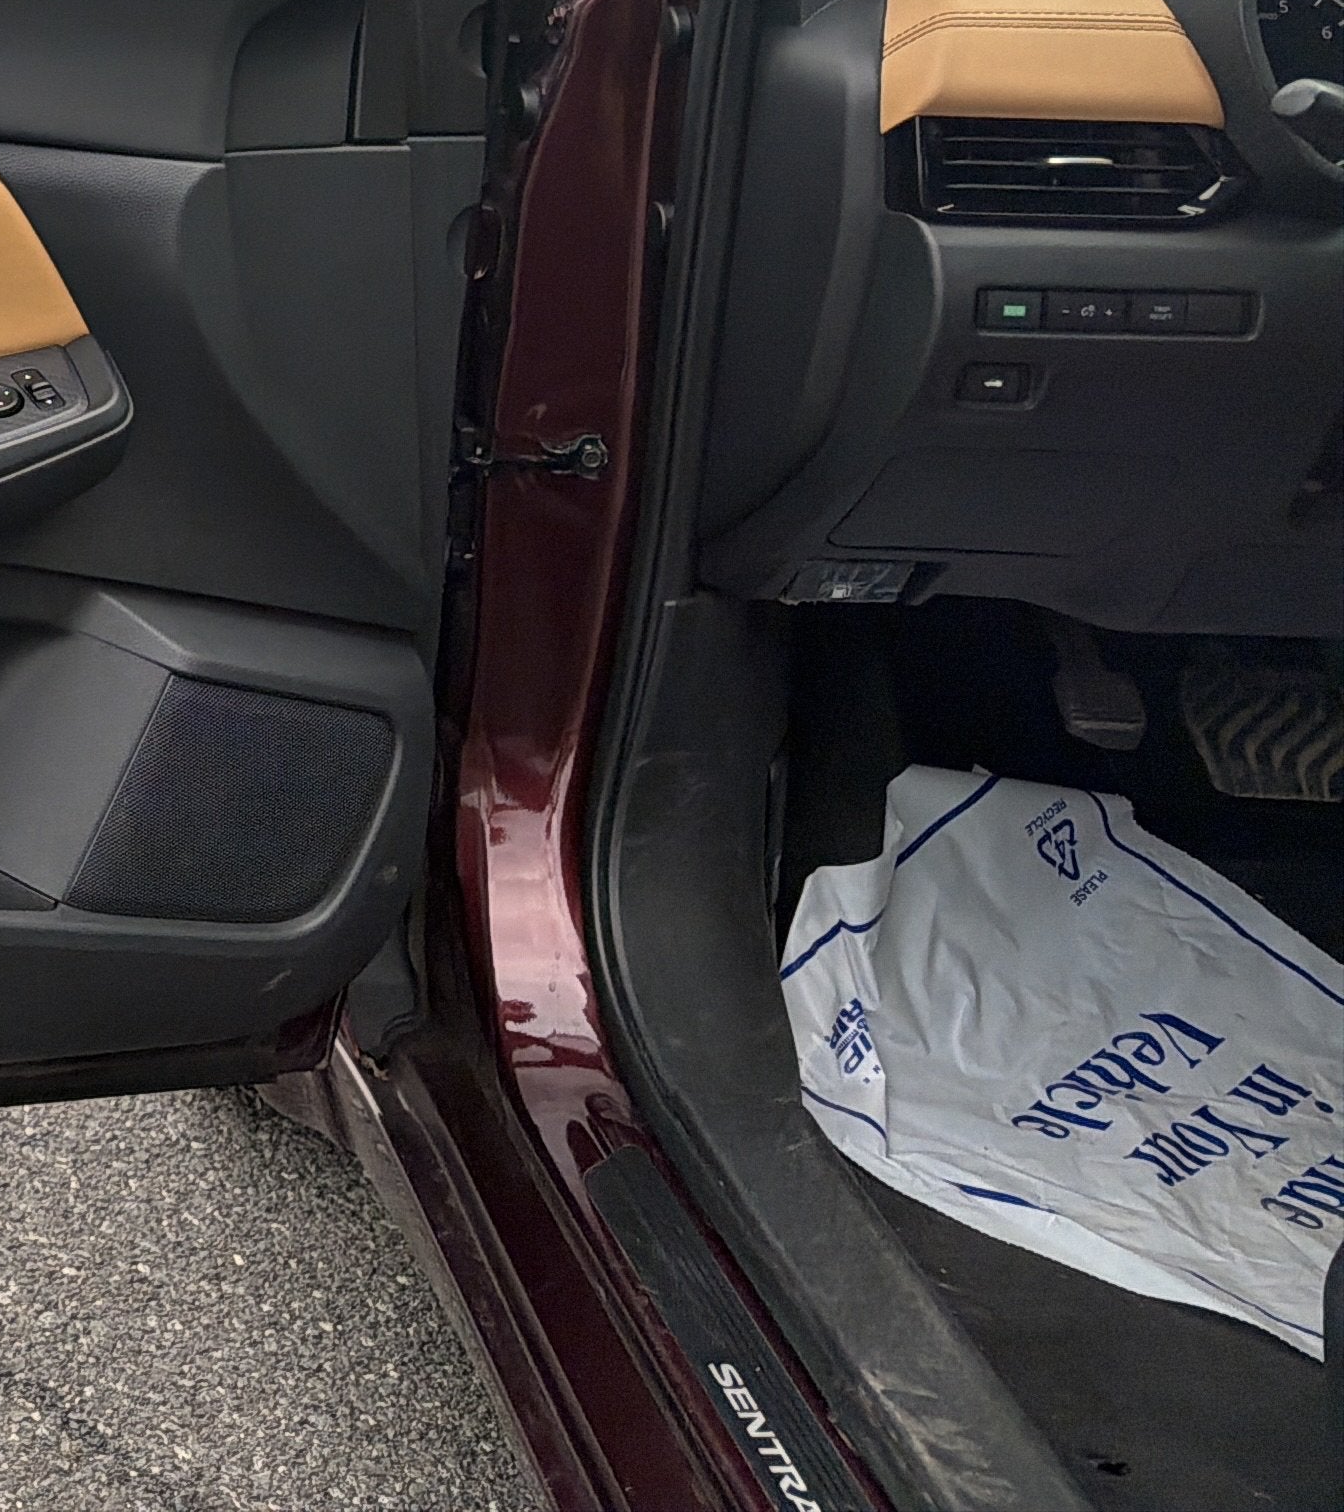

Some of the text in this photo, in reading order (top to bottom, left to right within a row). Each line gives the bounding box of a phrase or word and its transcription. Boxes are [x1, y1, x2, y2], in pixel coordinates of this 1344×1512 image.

[1278, 0, 1289, 14] 5
[1321, 25, 1333, 40] 6
[1025, 798, 1067, 837] RECYCLE
[1070, 870, 1108, 906] PLEASE
[1011, 1013, 1226, 1139] Vehicle
[1124, 1063, 1335, 1187] in Your
